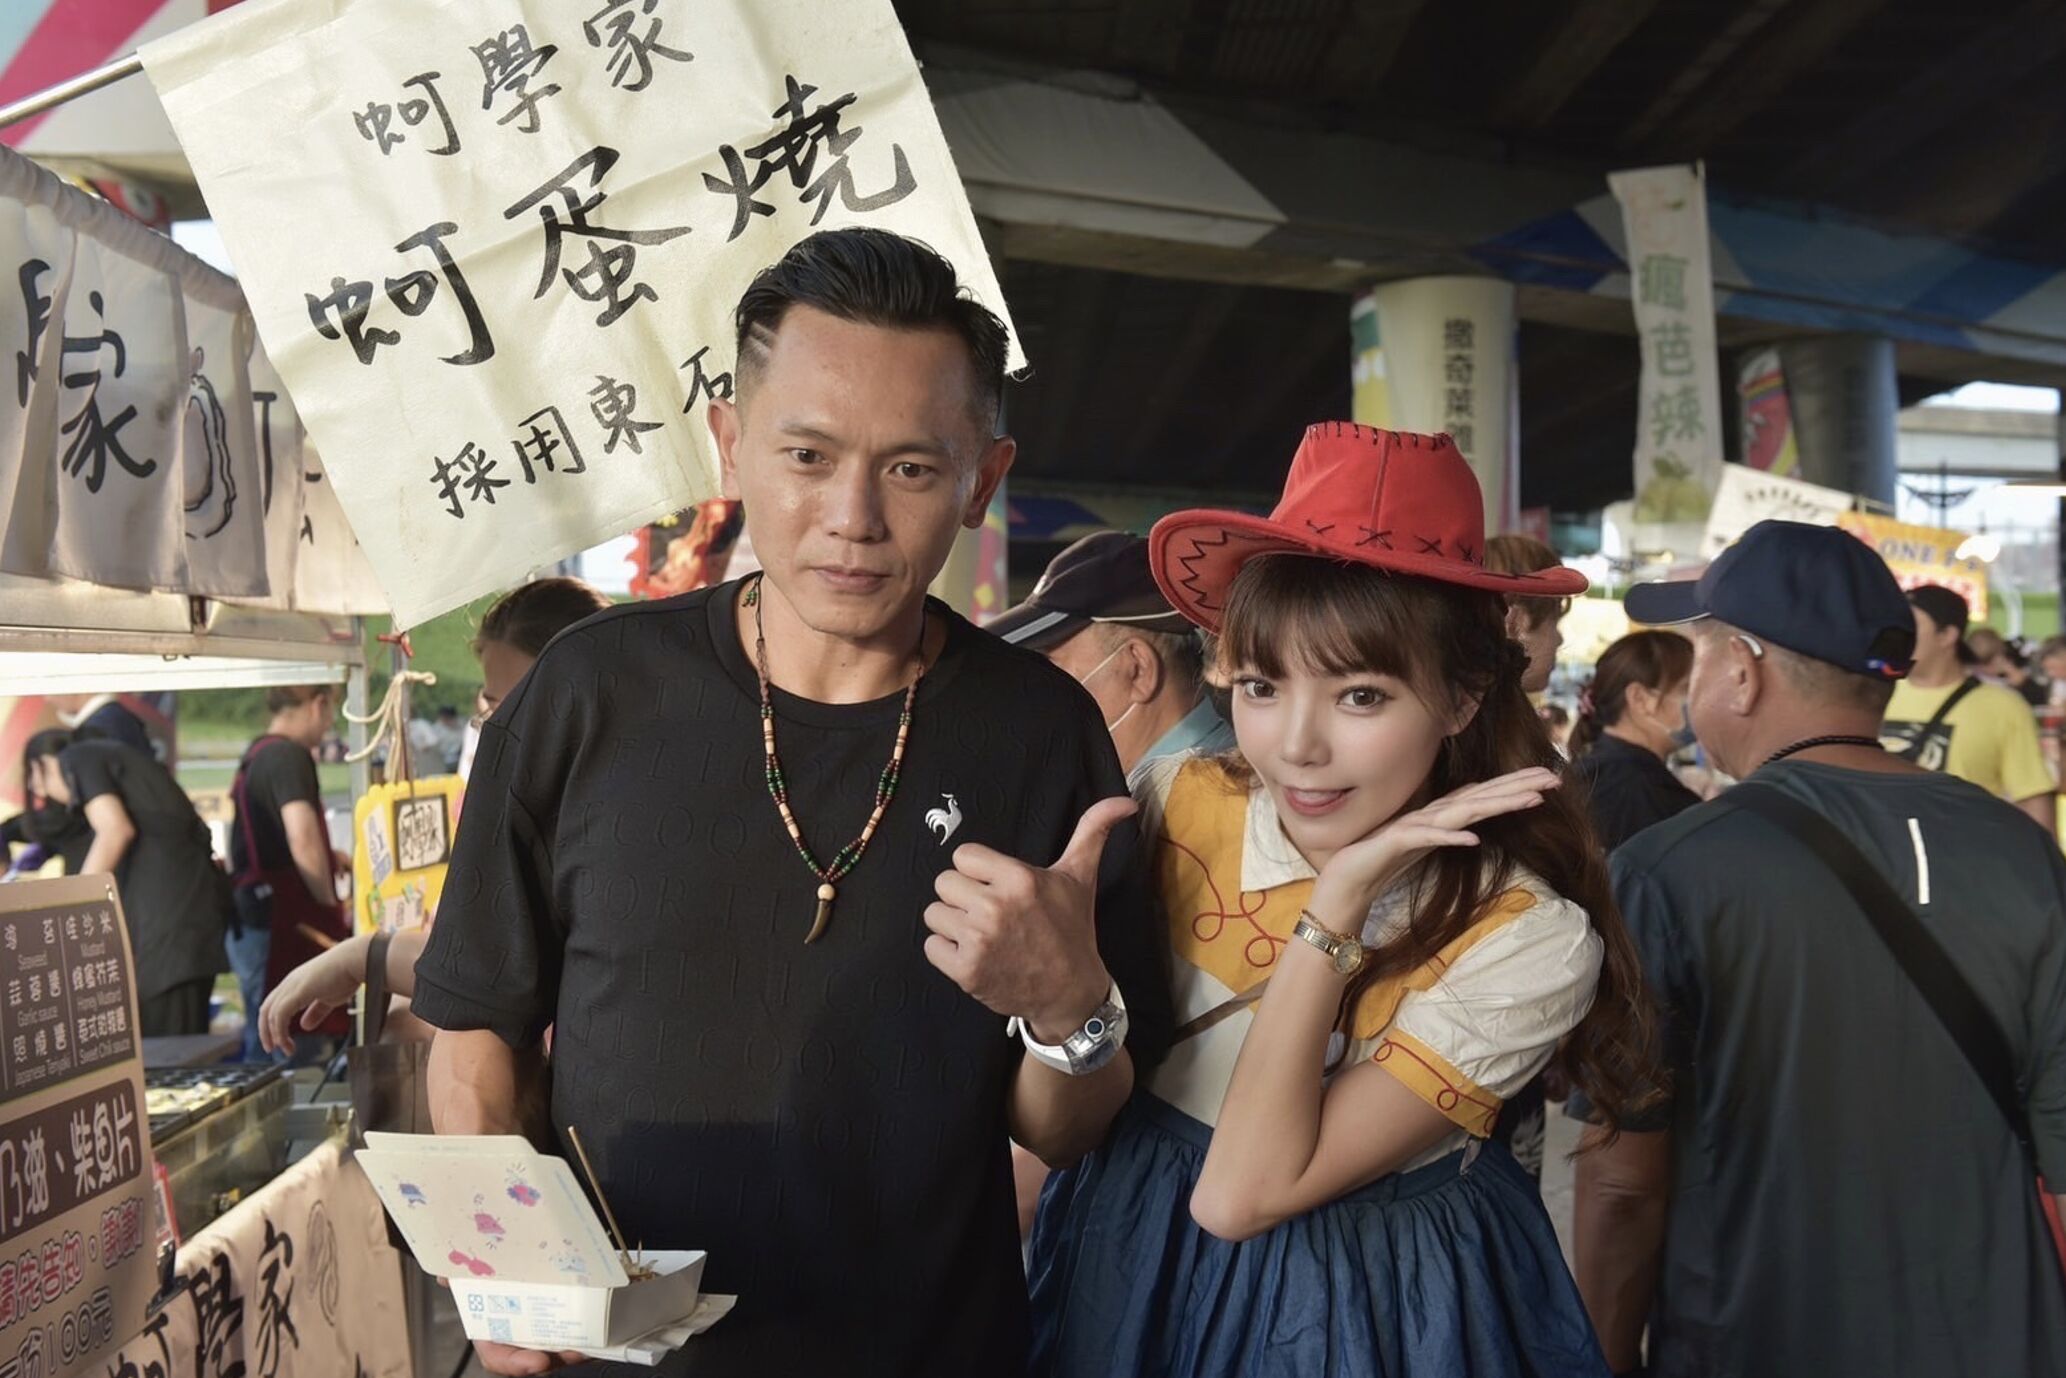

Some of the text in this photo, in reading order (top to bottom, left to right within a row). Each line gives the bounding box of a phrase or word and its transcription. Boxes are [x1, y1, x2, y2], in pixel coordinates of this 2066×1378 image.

[353, 0, 694, 155] 蚵學家
[304, 74, 918, 365] 蚵蛋燒
[430, 346, 734, 519] 採用東石
[1880, 537, 1936, 566] ONE
